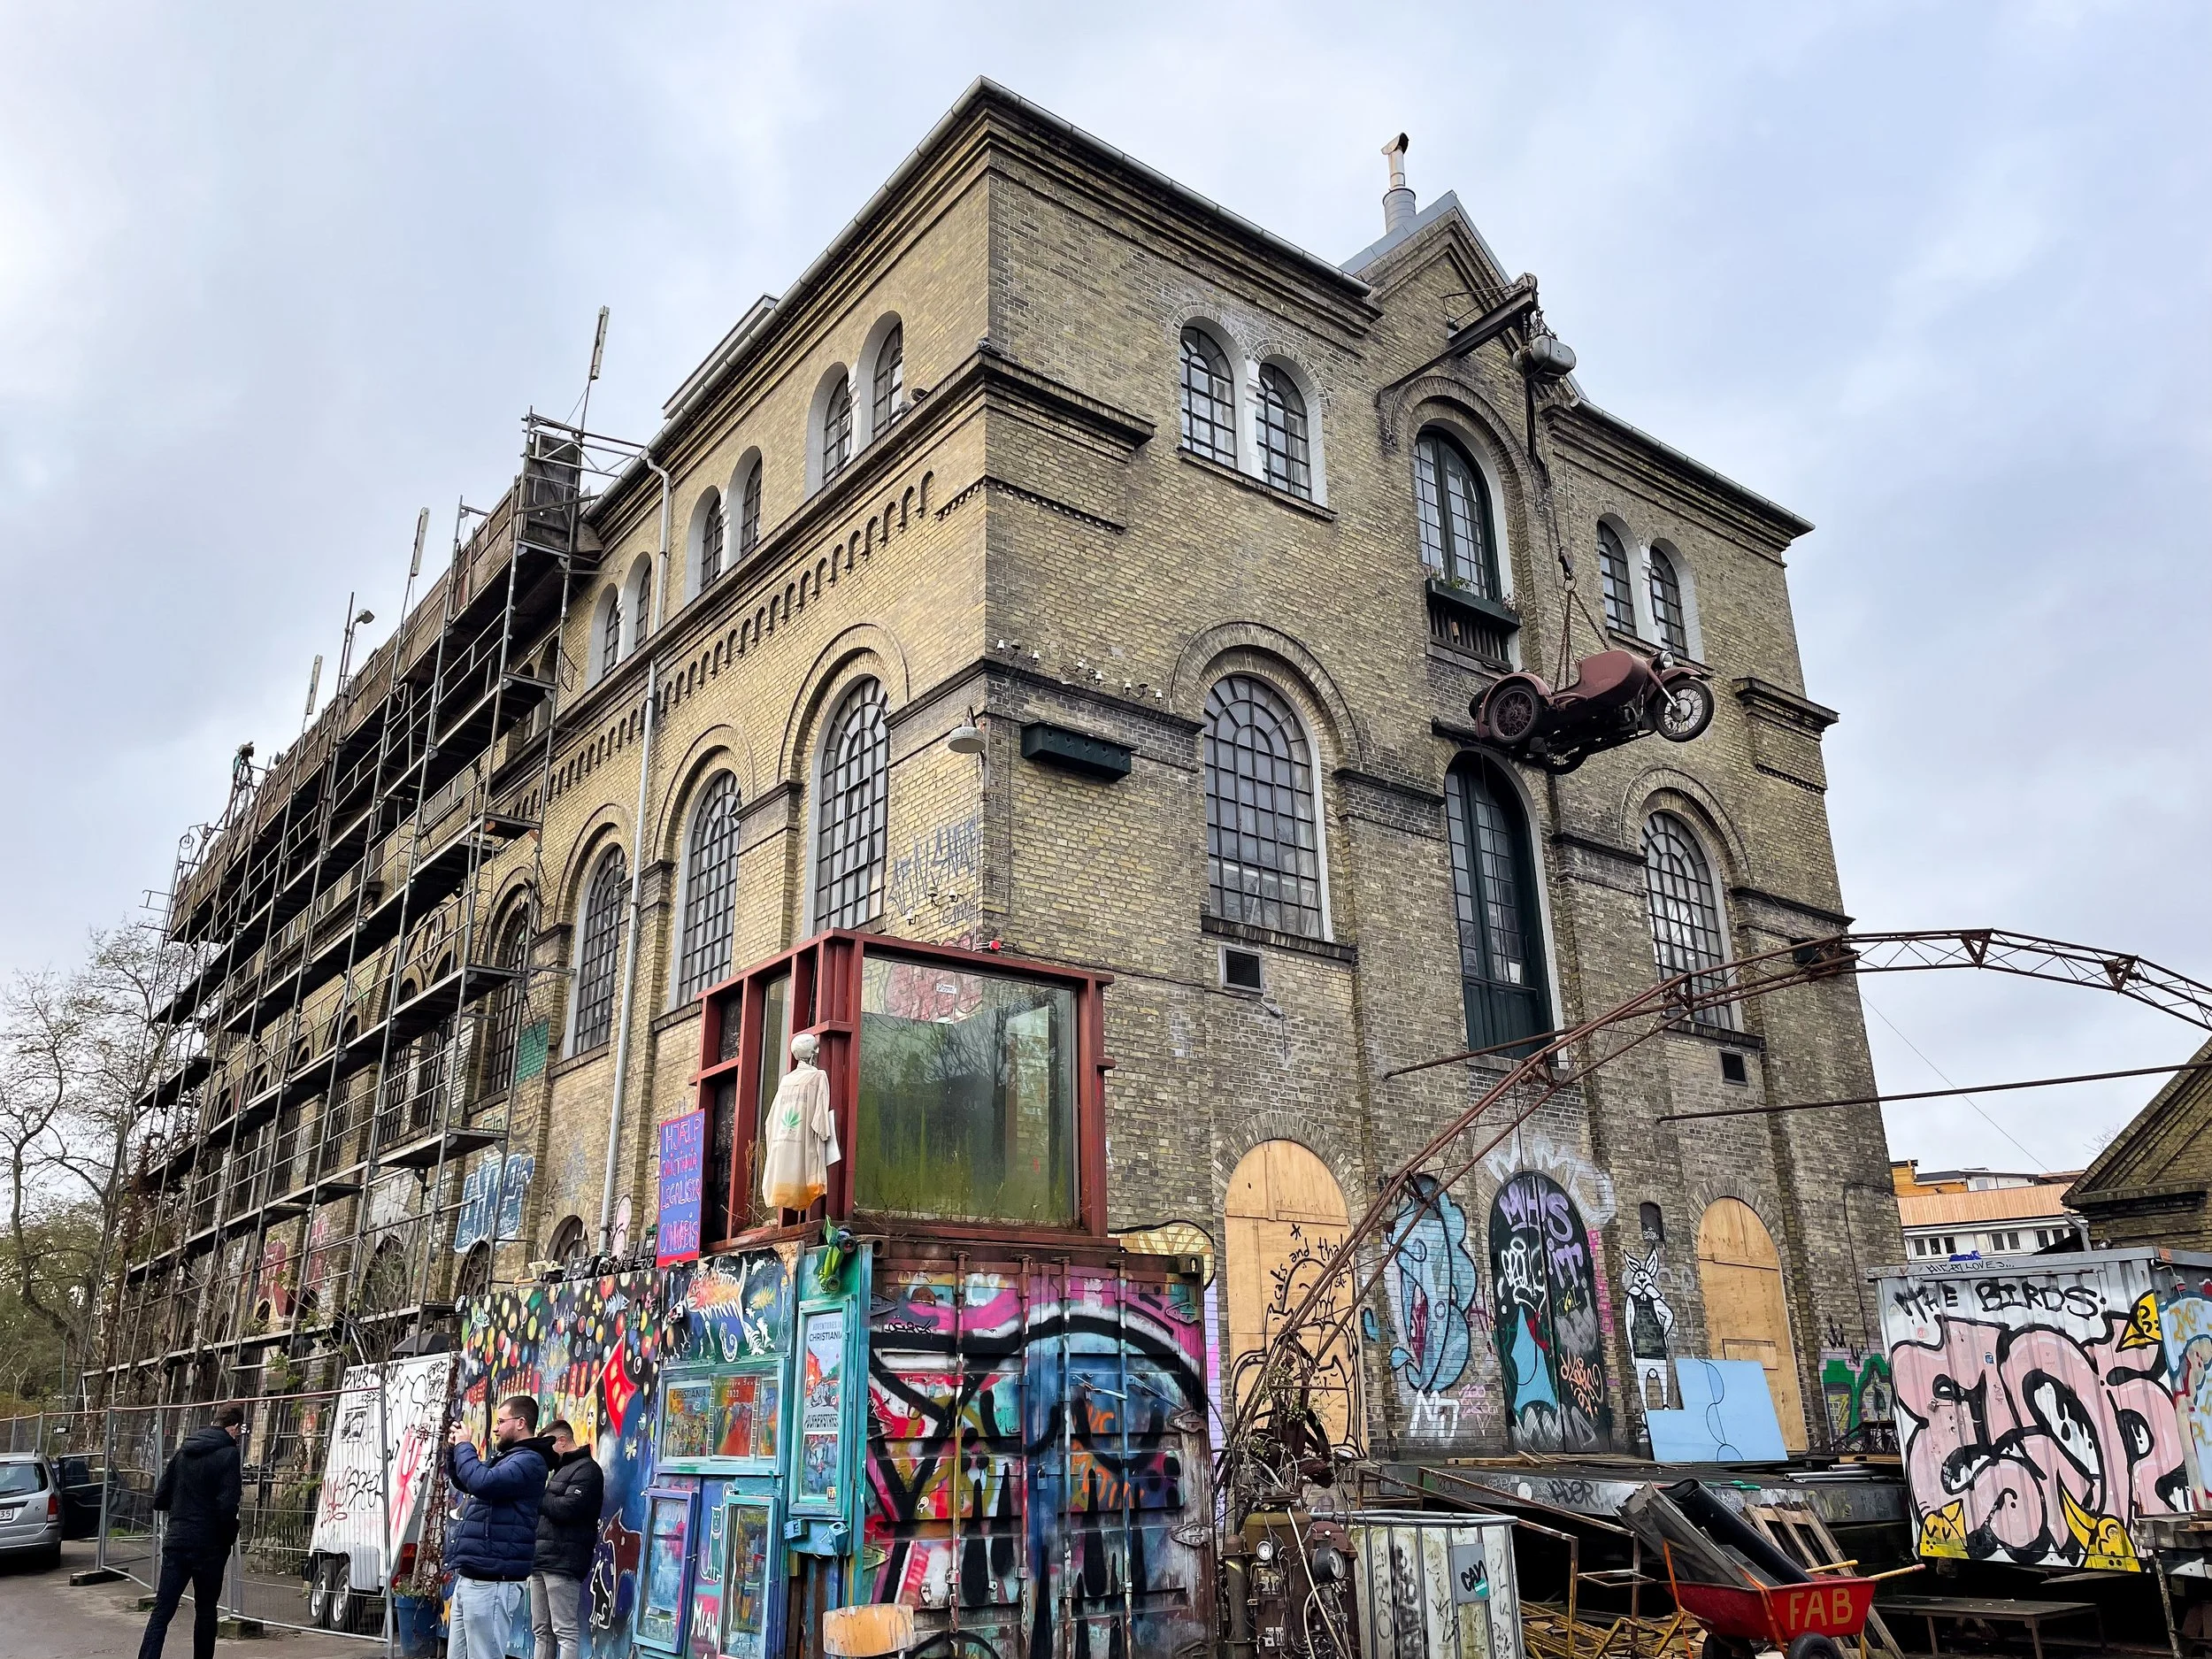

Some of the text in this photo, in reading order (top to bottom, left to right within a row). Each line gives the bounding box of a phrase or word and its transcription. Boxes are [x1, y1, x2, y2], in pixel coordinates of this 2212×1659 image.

[1271, 1263, 1288, 1301] cats
[1289, 1238, 1310, 1263] and
[1789, 1587, 1853, 1631] FAB
